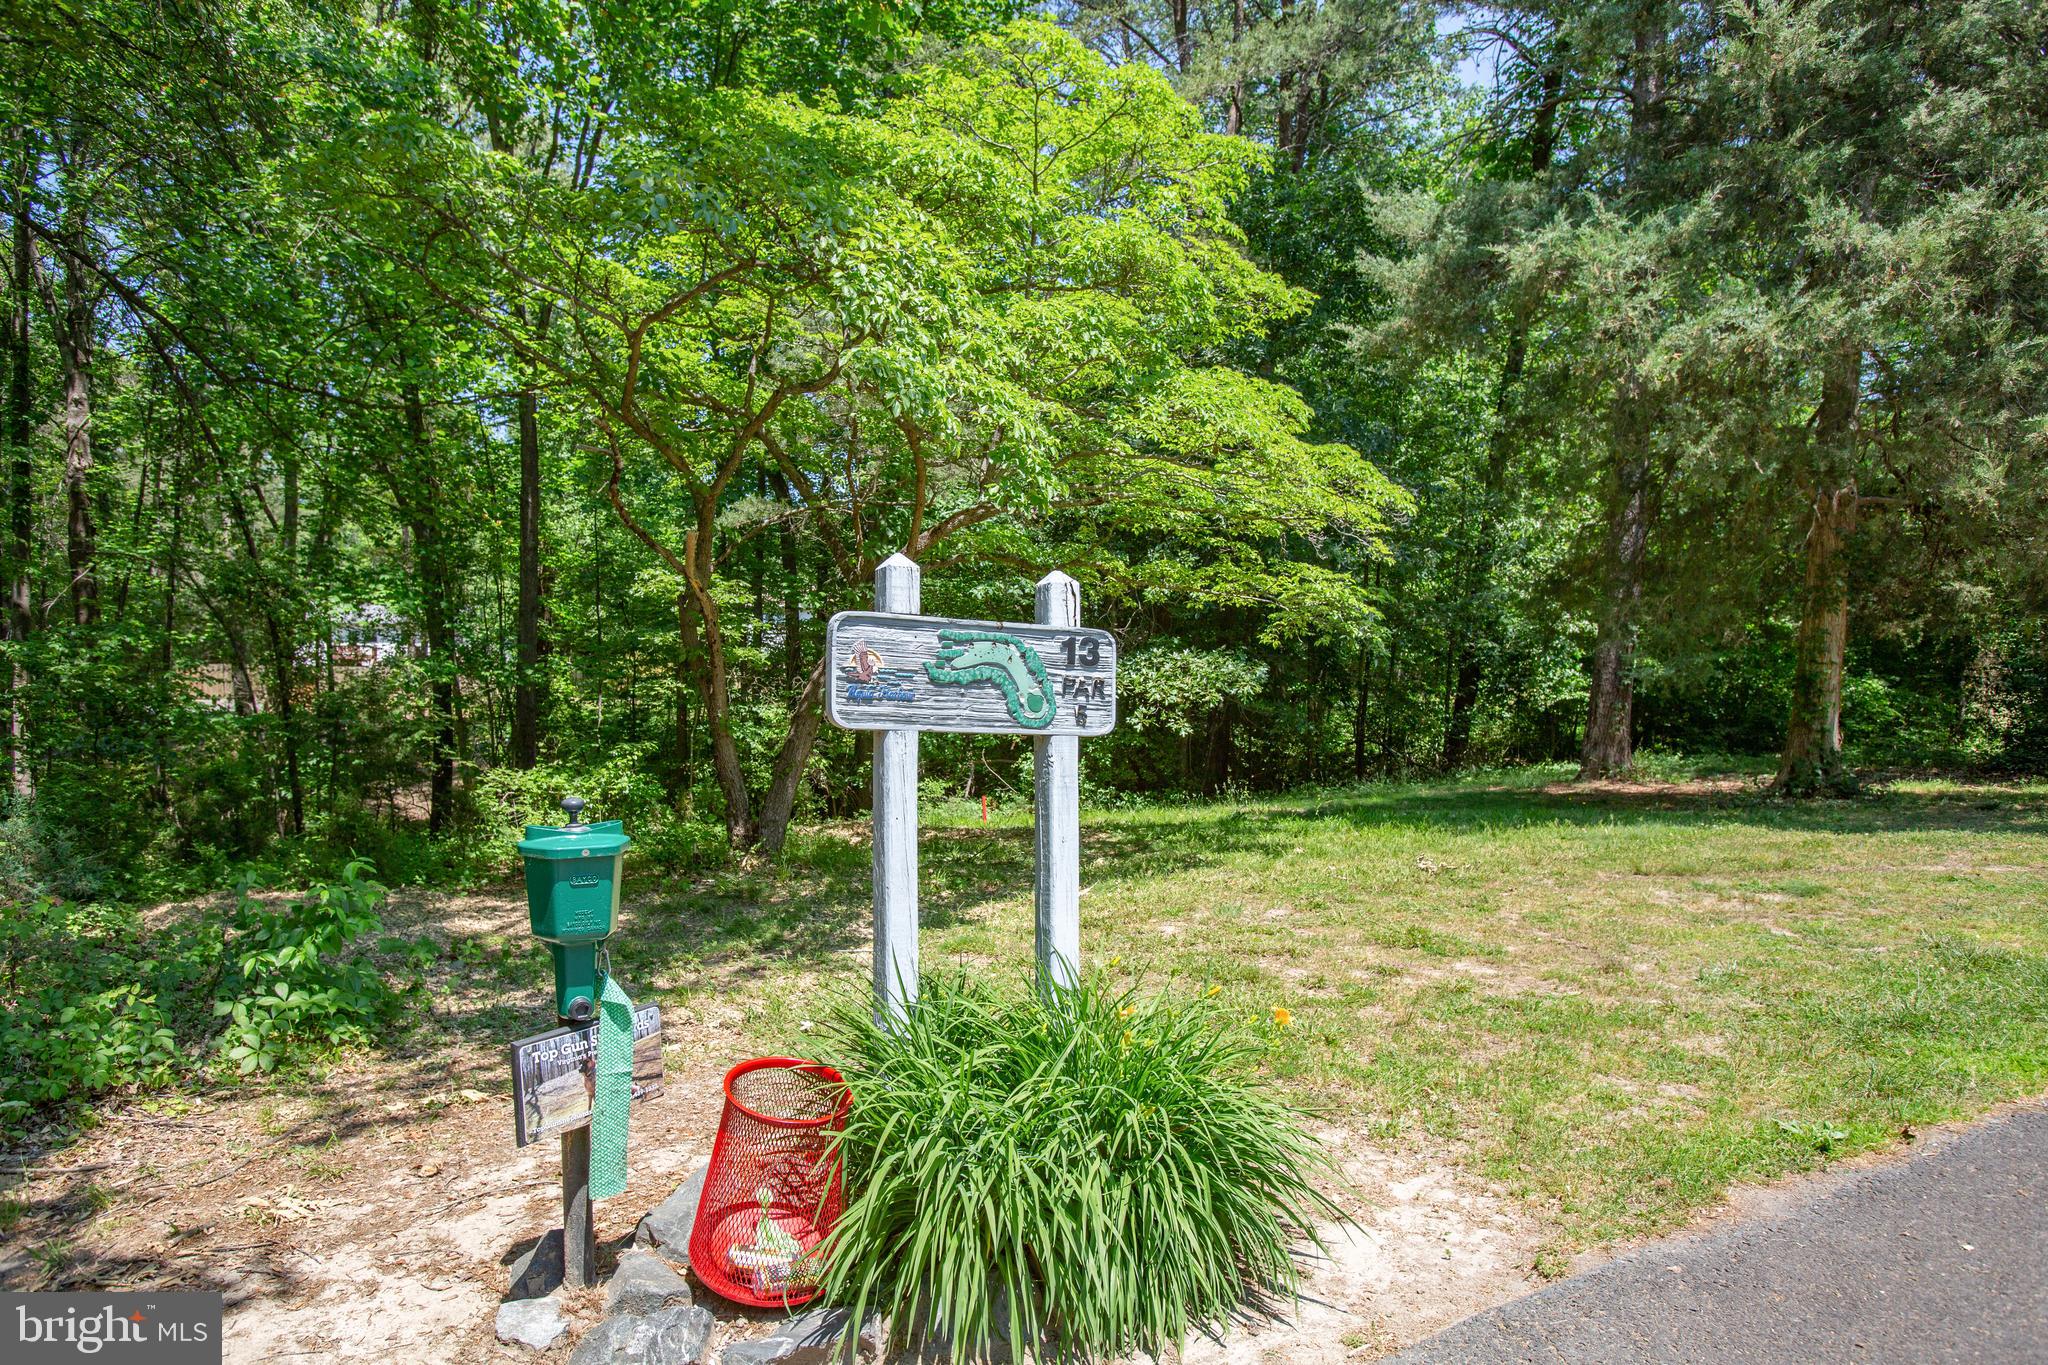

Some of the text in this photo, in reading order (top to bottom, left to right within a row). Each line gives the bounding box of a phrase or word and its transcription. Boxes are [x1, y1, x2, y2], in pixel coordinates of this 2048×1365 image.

[1061, 636, 1101, 667] 13
[1062, 674, 1106, 702] PAR
[532, 1048, 559, 1064] Top
[561, 1040, 589, 1055] Gun
